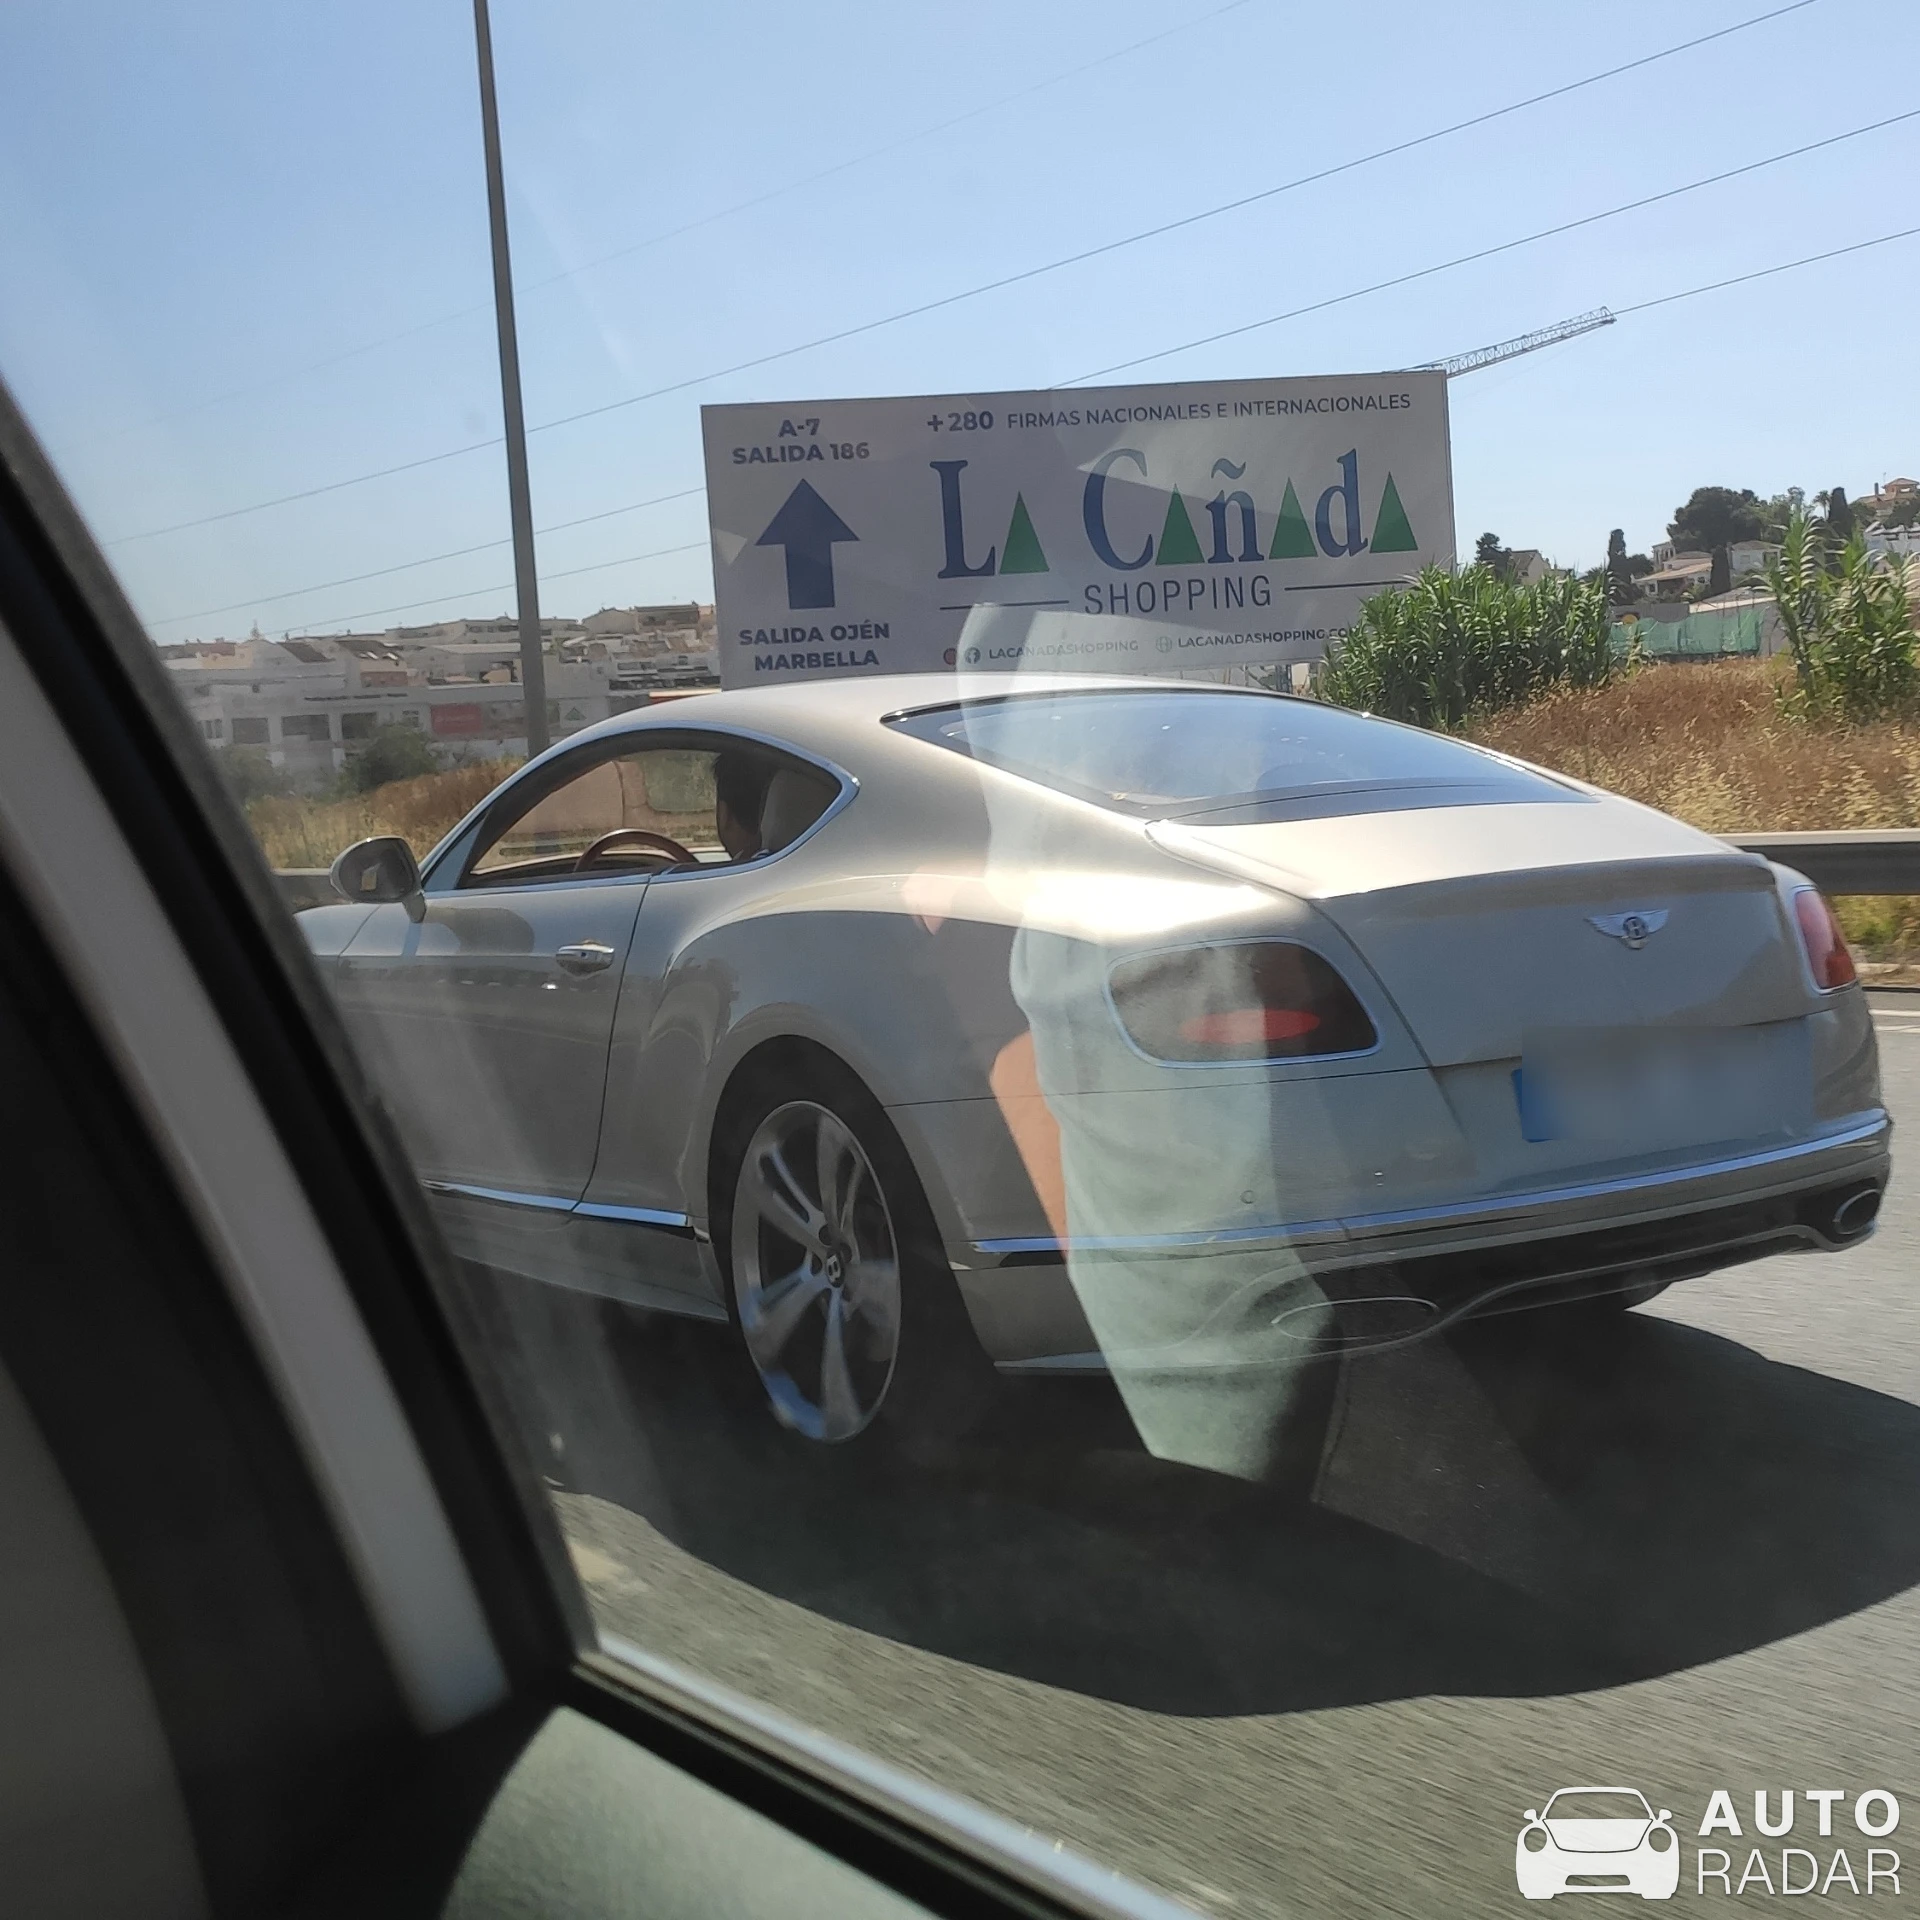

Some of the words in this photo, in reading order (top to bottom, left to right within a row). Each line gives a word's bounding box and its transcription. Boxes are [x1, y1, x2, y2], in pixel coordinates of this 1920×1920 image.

[1007, 409, 1081, 429] FIRMAS
[1086, 403, 1211, 424] NACIONALES
[1217, 402, 1228, 418] E
[1234, 394, 1411, 416] INTERNACIONALES
[778, 418, 821, 438] A-7
[732, 444, 824, 465] SALIDA
[830, 442, 869, 460] 186
[1084, 574, 1272, 616] SHOPPING
[739, 624, 825, 647] SALIDA
[830, 619, 890, 642] OJÉN
[754, 649, 879, 672] MARBELLA
